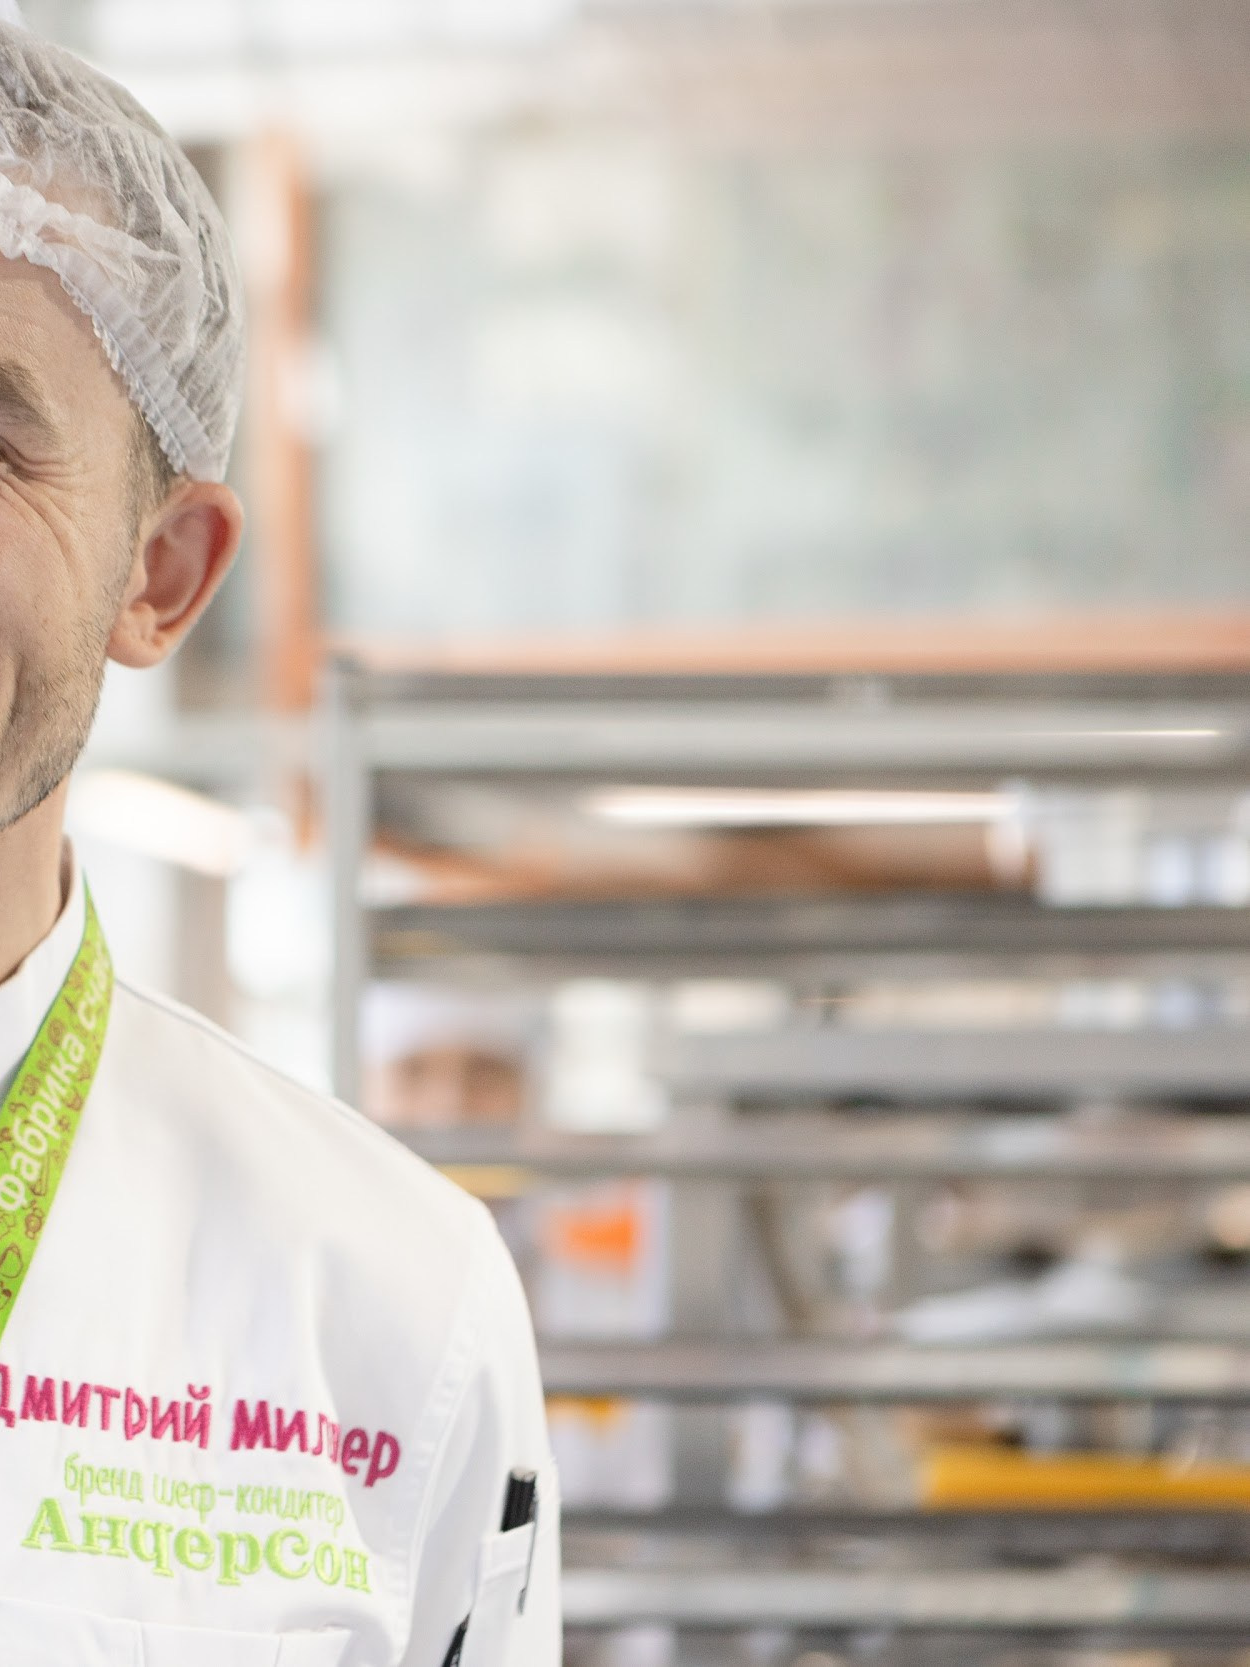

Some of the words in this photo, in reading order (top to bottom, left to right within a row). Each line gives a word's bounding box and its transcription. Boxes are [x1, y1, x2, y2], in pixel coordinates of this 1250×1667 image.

[63, 1450, 144, 1507] бренд
[152, 1472, 346, 1538] шеф-кондитер
[20, 1496, 373, 1594] АндерСон
